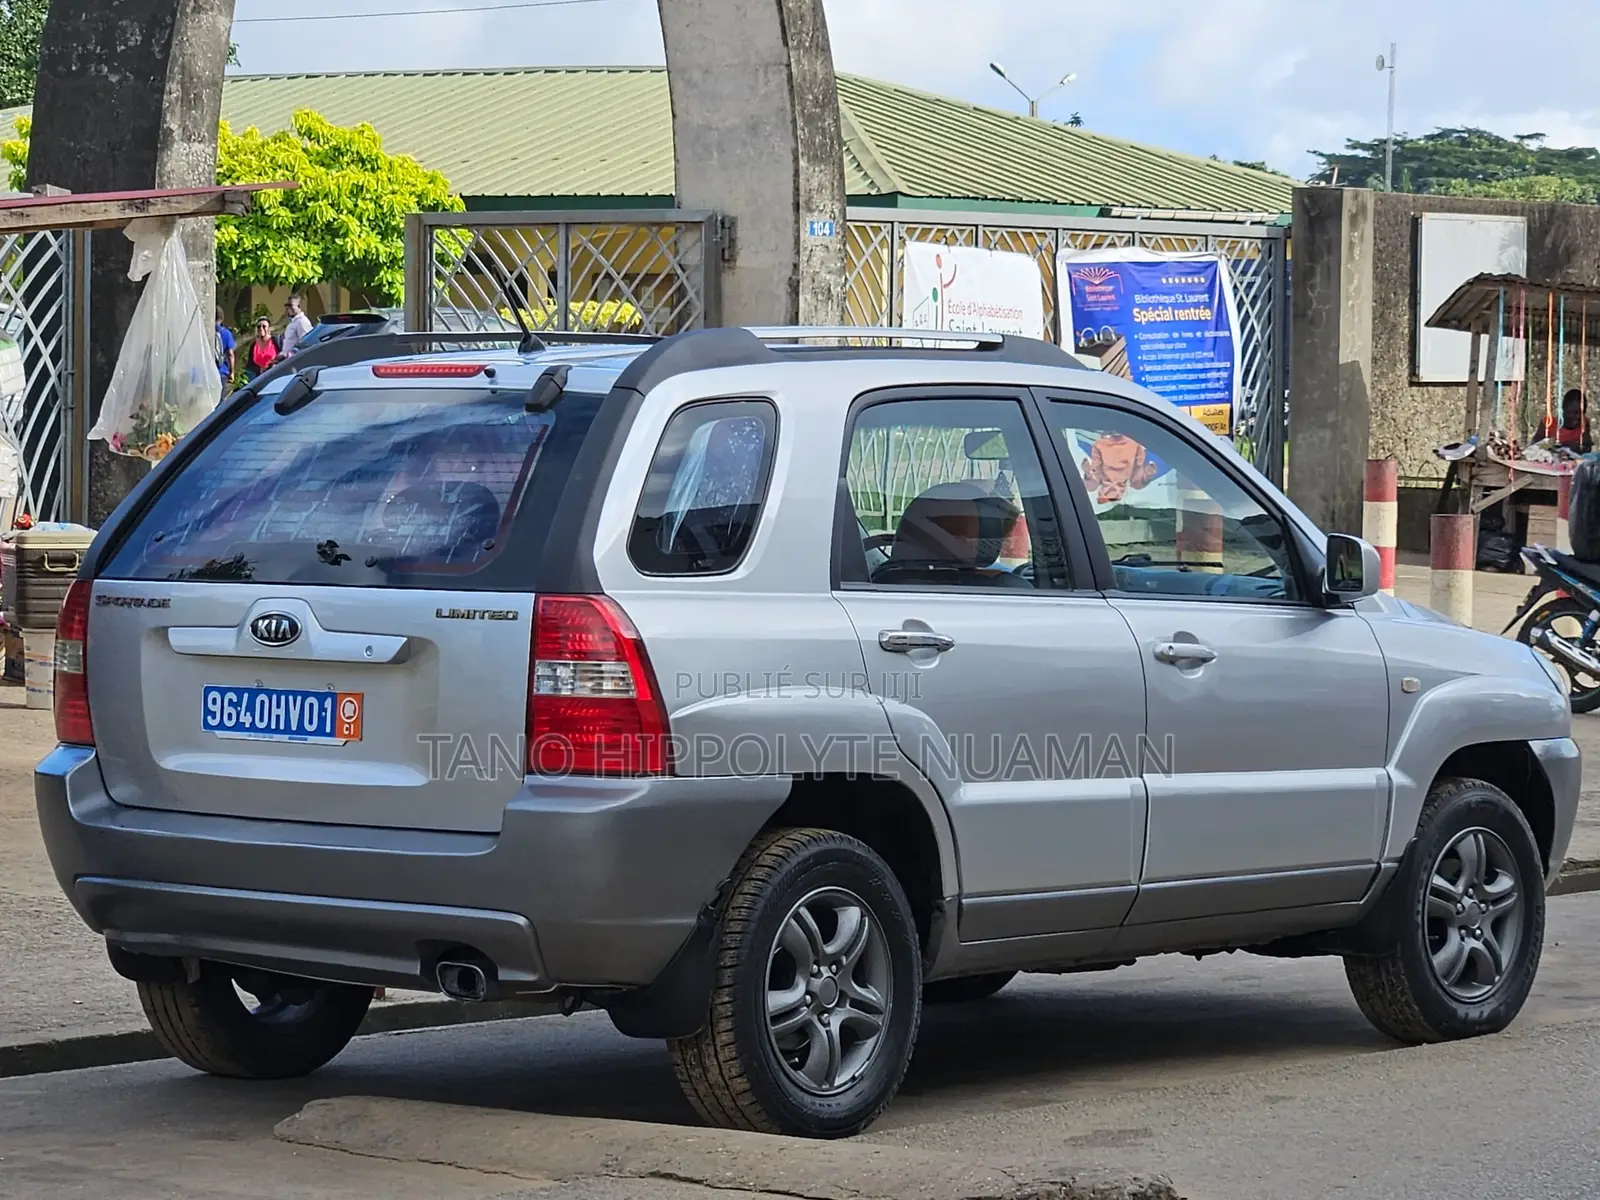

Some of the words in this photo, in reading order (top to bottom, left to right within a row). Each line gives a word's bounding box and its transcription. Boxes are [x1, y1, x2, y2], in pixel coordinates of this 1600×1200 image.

[813, 221, 831, 237] 104
[1185, 293, 1209, 303] Laurent
[948, 298, 966, 315] École
[967, 301, 1024, 320] d'Alphabétisation
[1133, 305, 1174, 325] Spécial
[1174, 305, 1212, 321] rentrée
[95, 595, 171, 608] SPORTAGE
[435, 608, 519, 621] LIMITED
[257, 619, 291, 638] KIA
[207, 690, 332, 733] 9640HV01
[343, 724, 354, 735] CI
